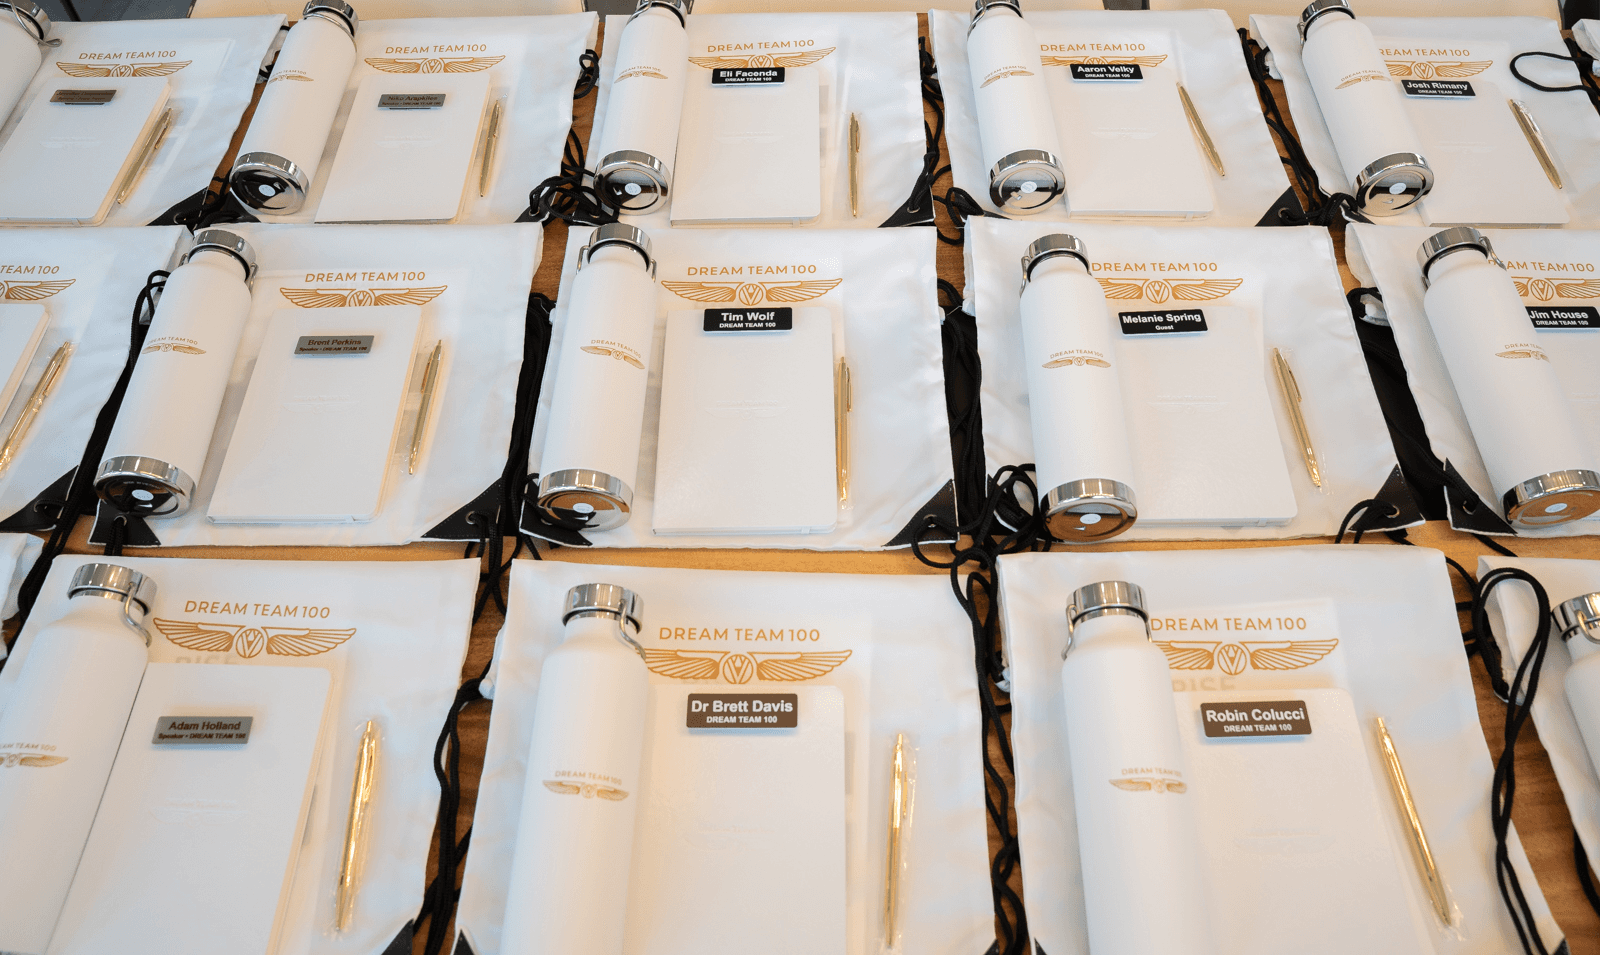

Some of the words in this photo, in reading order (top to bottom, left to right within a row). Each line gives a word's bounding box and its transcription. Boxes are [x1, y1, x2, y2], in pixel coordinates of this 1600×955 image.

[385, 46, 430, 54] DREAM
[433, 45, 464, 53] TEAM
[466, 44, 487, 52] 100
[707, 42, 754, 52] DREAM
[758, 41, 790, 49] TEAM
[793, 39, 815, 48] 100
[1040, 43, 1086, 52] DREAM
[1090, 43, 1123, 52] TEAM
[1124, 43, 1146, 52] 100
[78, 52, 122, 60] DREAM
[126, 51, 156, 59] TEAM
[158, 50, 176, 58] 100
[1378, 48, 1412, 56] REAM
[1415, 48, 1448, 57] TEAM
[1449, 49, 1470, 57] 100
[1108, 66, 1134, 74] Velky
[1431, 82, 1468, 90] Rimany
[0, 265, 36, 274] TEAM
[38, 266, 60, 274] 100
[688, 266, 743, 276] DREAM
[748, 265, 788, 275] TEAM
[791, 264, 817, 274] 100
[1092, 262, 1146, 272] DREAM
[1150, 262, 1190, 272] TEAM
[1192, 262, 1218, 272] 100
[1530, 262, 1569, 272] TEAM
[1570, 264, 1595, 273] 100
[305, 272, 357, 283] DREAM
[361, 272, 399, 282] TEAM
[402, 271, 426, 282] 100
[721, 312, 744, 322] Tim
[746, 312, 776, 321] Wolf
[1122, 314, 1164, 324] Melanie
[1166, 312, 1202, 324] Spring
[1530, 310, 1550, 320] Jim
[1550, 311, 1589, 320] House
[146, 336, 166, 345] DREAM
[186, 338, 198, 346] 100
[331, 338, 362, 346] Perkins
[590, 339, 616, 347] DREAM
[617, 342, 634, 353] TEAM
[633, 349, 642, 359] 100
[1050, 350, 1075, 359] DREAM
[1094, 350, 1104, 358] 100
[184, 600, 248, 616] DREAM
[254, 603, 298, 618] TEAM
[302, 605, 331, 619] 100
[1150, 618, 1219, 632] DREAM
[1224, 617, 1272, 631] TEAM
[1276, 617, 1307, 631] 100
[659, 627, 729, 642] DREAM
[734, 628, 784, 642] TEAM
[788, 628, 820, 643] 100
[691, 700, 710, 712] Dr
[712, 700, 749, 712] Brett
[752, 700, 794, 712] Davis
[706, 716, 737, 724] DREAM
[738, 716, 762, 724] TEAM
[763, 716, 778, 724] 100
[1206, 709, 1249, 722] Robin
[1251, 708, 1306, 722] Colucci
[168, 721, 200, 730] Adam
[201, 721, 242, 730] Holland
[1223, 725, 1253, 733] DREAM
[1254, 724, 1278, 732] TEAM
[1278, 724, 1292, 732] 100
[1121, 768, 1154, 776] DREAM
[554, 770, 586, 778] DREAM
[588, 772, 610, 782] TEAM
[610, 776, 622, 786] 100
